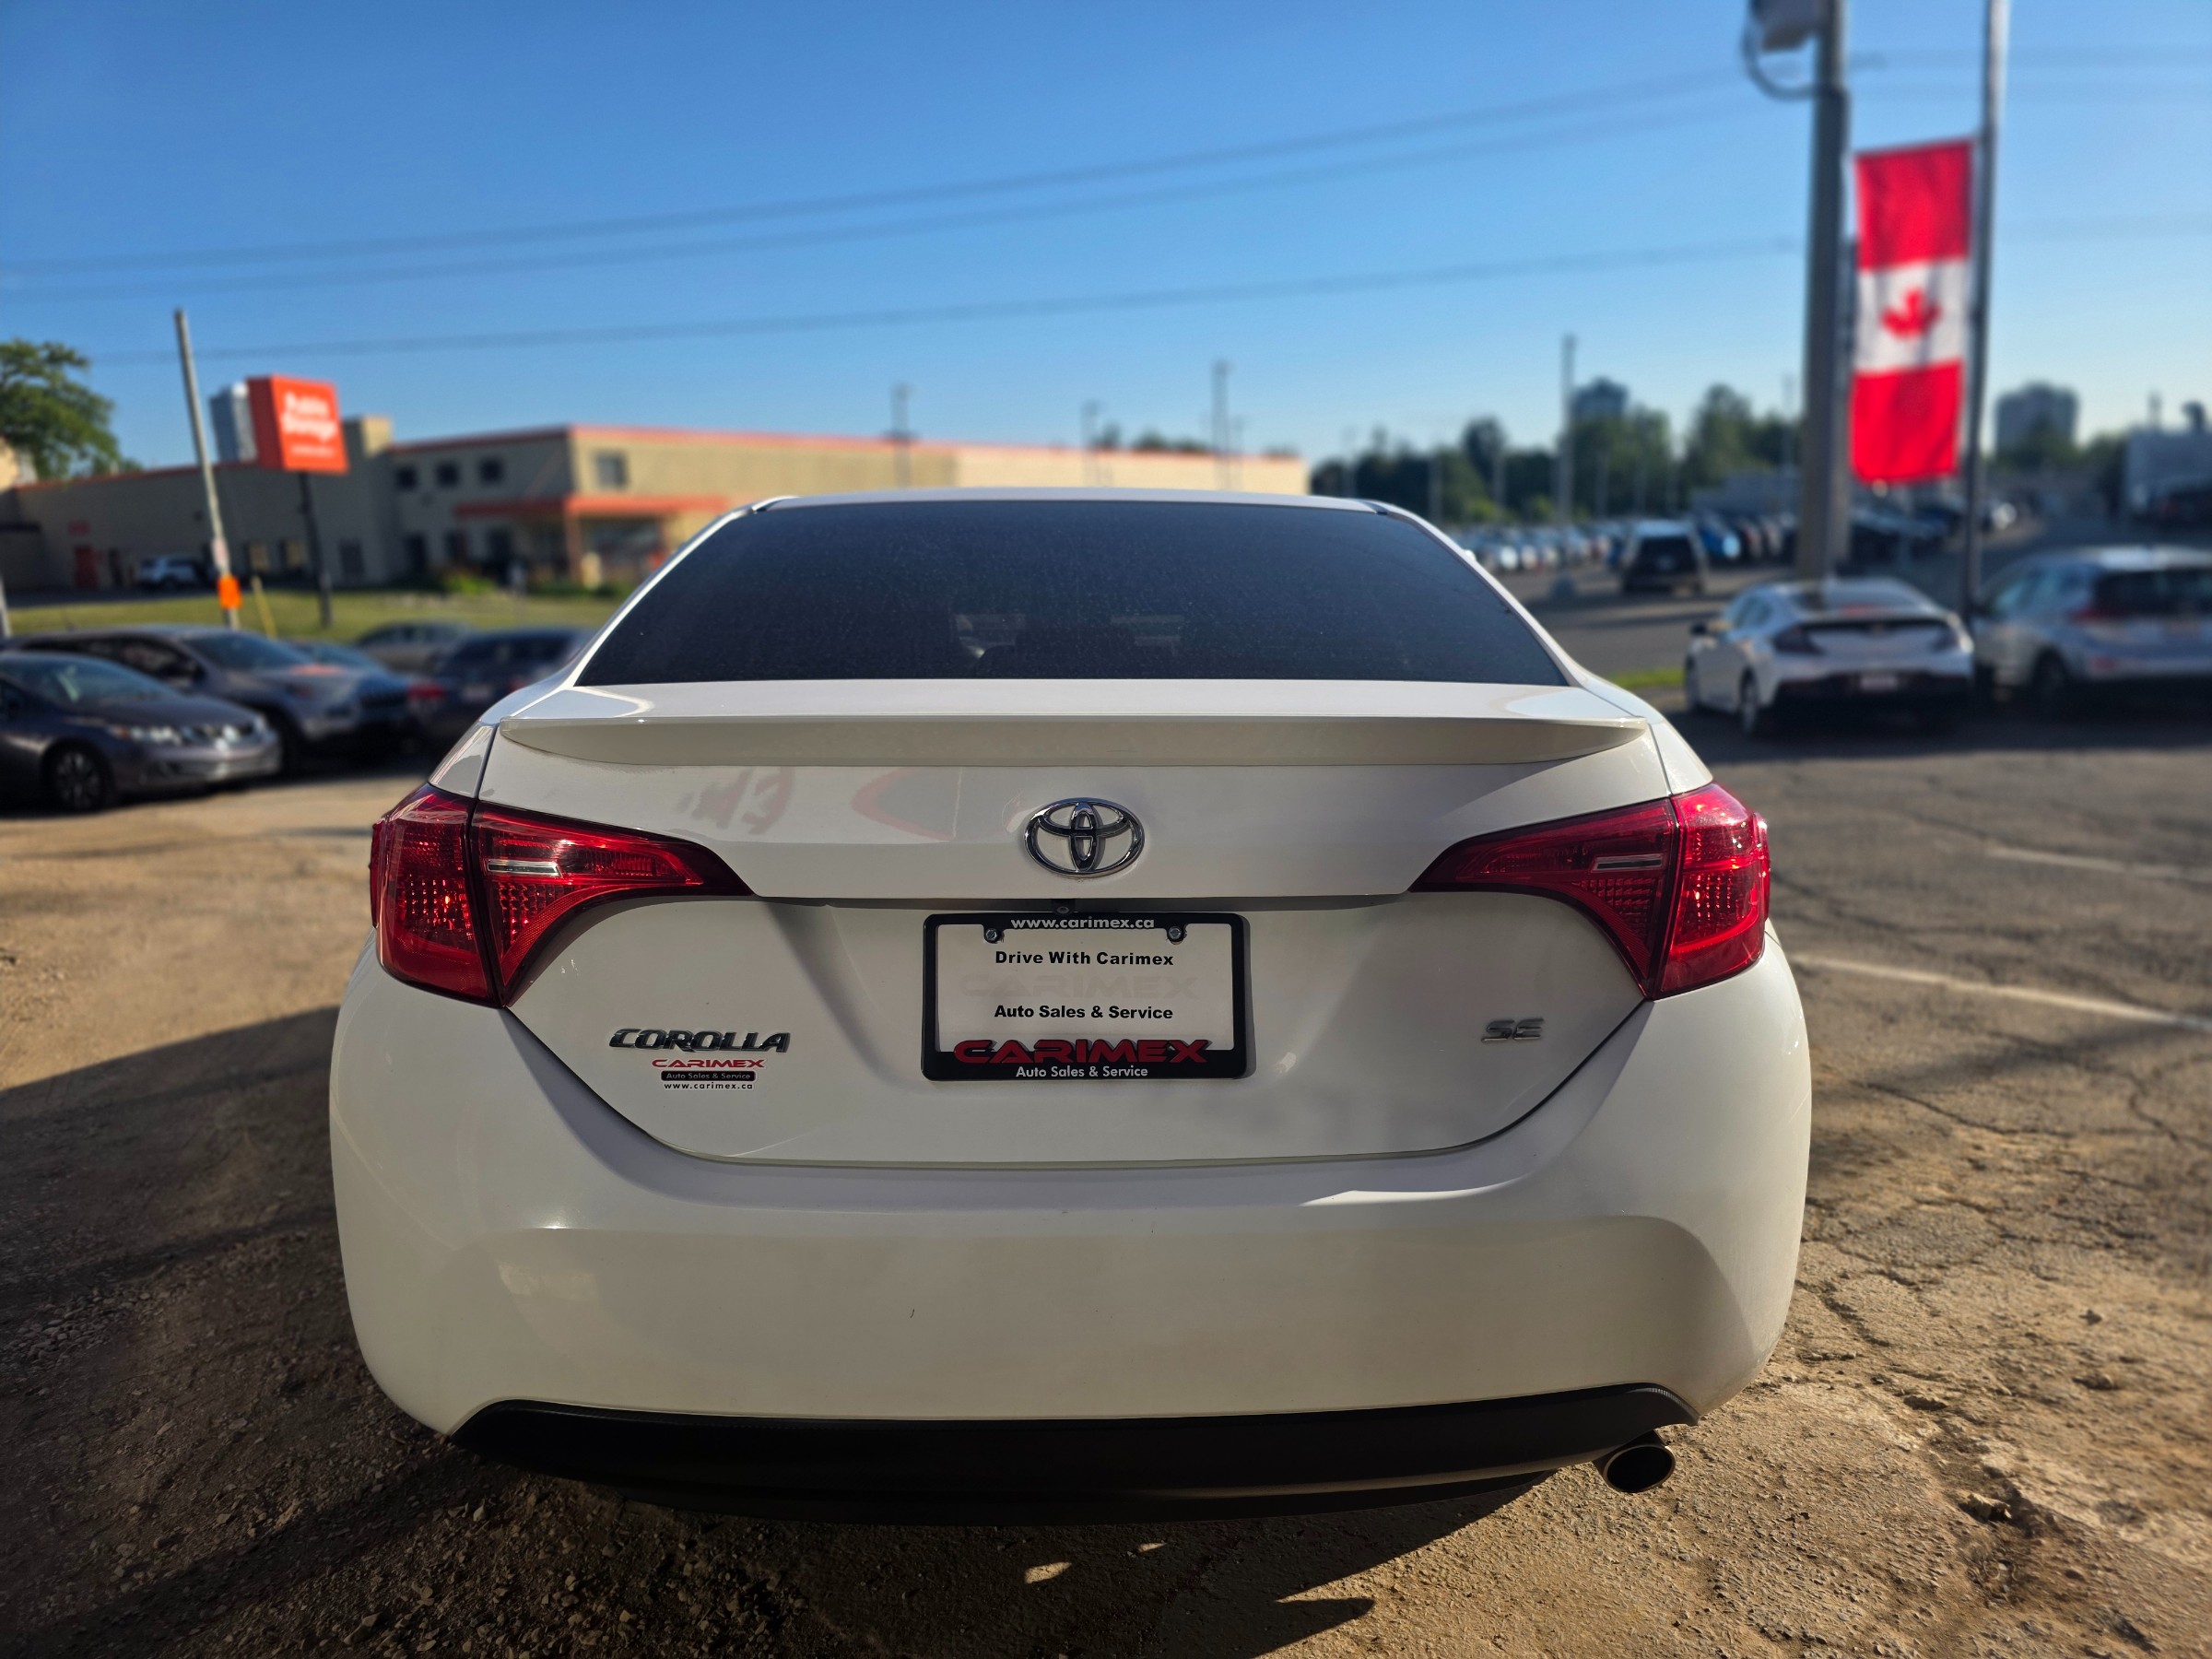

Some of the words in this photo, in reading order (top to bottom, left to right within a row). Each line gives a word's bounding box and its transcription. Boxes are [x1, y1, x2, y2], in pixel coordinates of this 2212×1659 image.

[1010, 915, 1155, 930] www.carimex.ca
[994, 950, 1043, 964] Drive
[1049, 951, 1091, 965] With
[1096, 951, 1174, 966] Carimex
[994, 1005, 1034, 1018] Auto
[1039, 1005, 1086, 1018] Sales
[1090, 1006, 1104, 1018] &
[1108, 1006, 1173, 1019] Service
[1481, 1018, 1544, 1042] SE
[609, 1029, 790, 1053] COROLLA
[954, 1039, 1209, 1064] CARIMEX
[652, 1059, 765, 1068] CARIMEX
[665, 1072, 686, 1080] Auto
[688, 1072, 711, 1080] Sales
[721, 1072, 751, 1080] Service
[1015, 1065, 1047, 1077] Auto
[1051, 1065, 1085, 1077] Sales
[1088, 1065, 1099, 1077] &
[1102, 1065, 1148, 1077] Service
[664, 1081, 753, 1089] www.carimex.ca
